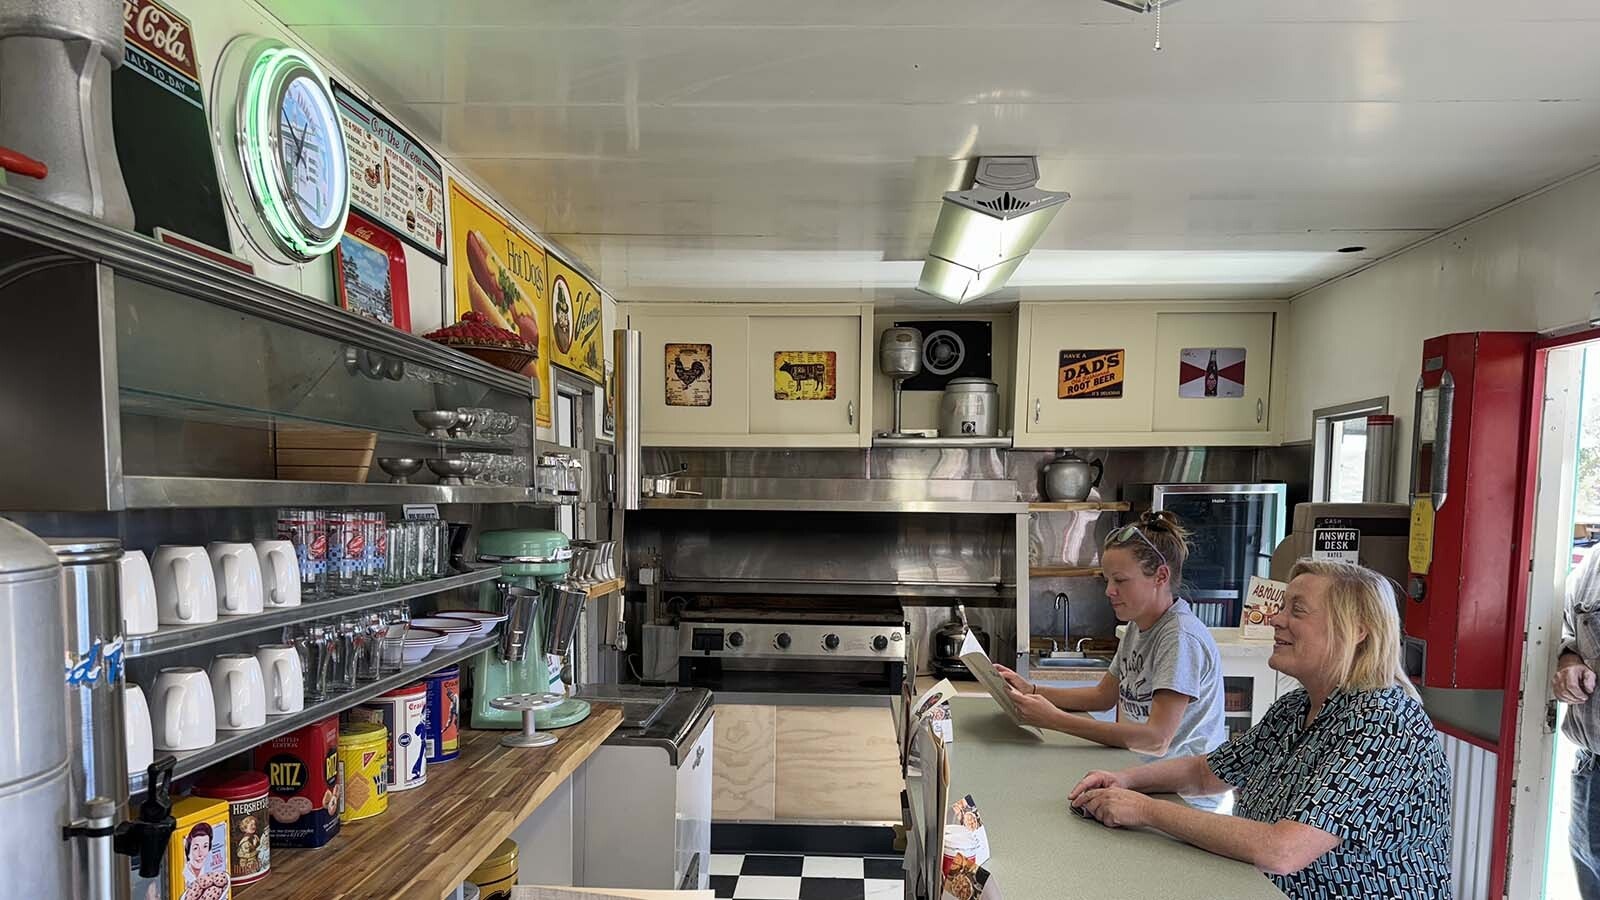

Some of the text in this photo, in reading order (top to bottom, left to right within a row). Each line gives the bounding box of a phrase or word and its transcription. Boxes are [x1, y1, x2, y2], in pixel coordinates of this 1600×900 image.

[371, 117, 384, 137] On
[384, 127, 400, 149] the
[506, 238, 544, 299] Hot Dogs
[1063, 353, 1120, 382] DAD'S
[1067, 373, 1115, 395] ROOT BEER
[1319, 531, 1356, 541] ANSWER
[1324, 541, 1349, 550] DESK
[270, 763, 301, 786] RITZ
[326, 752, 338, 781] RITZ
